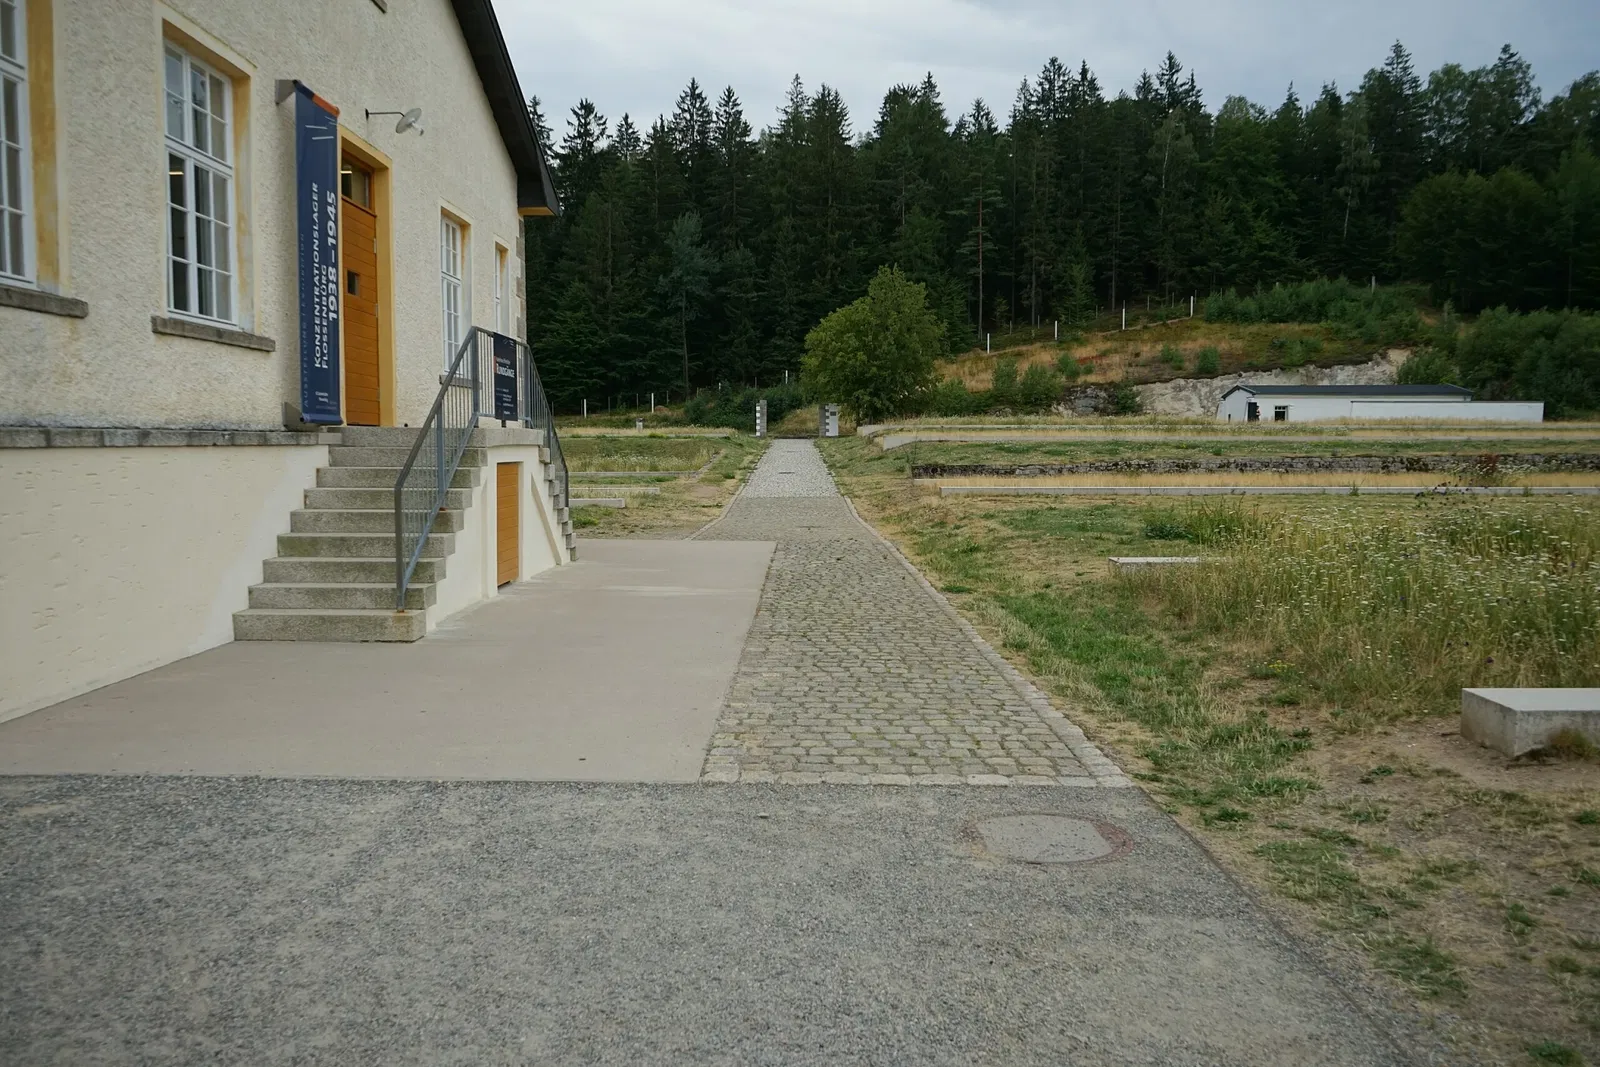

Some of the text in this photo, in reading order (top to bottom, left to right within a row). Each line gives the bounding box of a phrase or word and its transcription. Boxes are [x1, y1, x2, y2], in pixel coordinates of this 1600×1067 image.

[327, 191, 336, 247] 1945
[312, 182, 321, 368] KONZENTRATIONSLAGER
[327, 266, 338, 321] 1938
[321, 265, 329, 369] FLOSSENBÜRG
